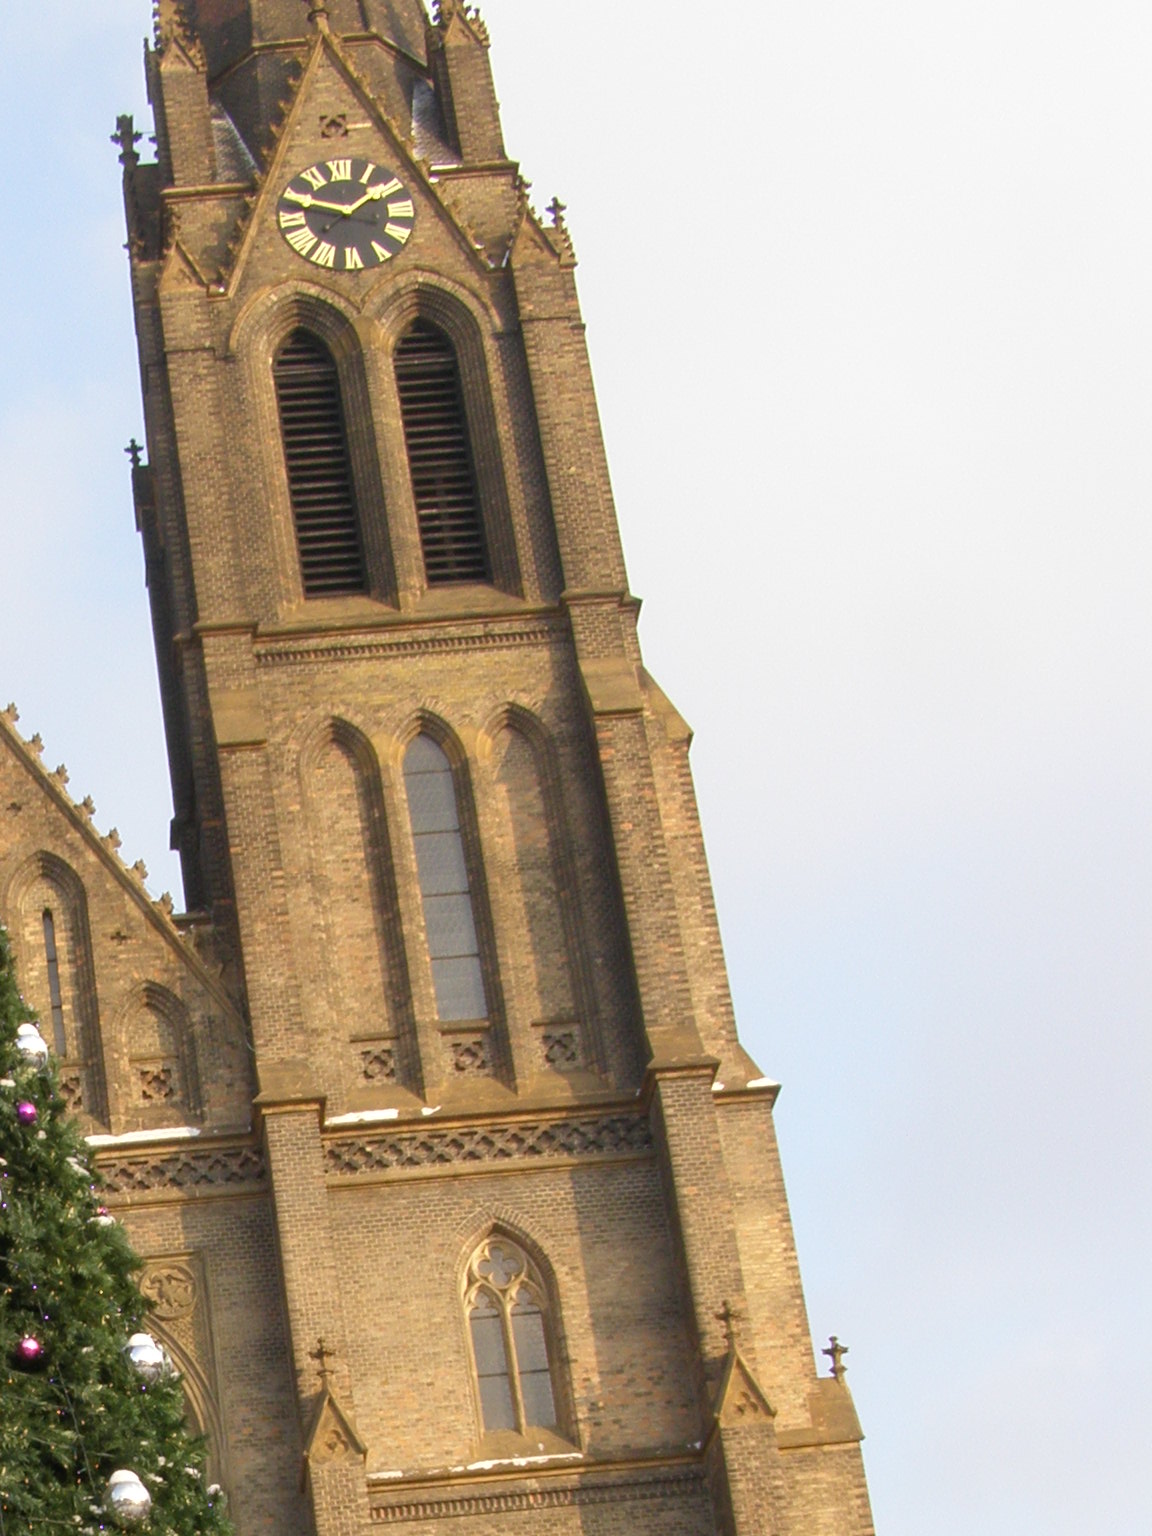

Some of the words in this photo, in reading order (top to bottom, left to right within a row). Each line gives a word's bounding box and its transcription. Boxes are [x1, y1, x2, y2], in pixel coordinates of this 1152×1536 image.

[300, 166, 327, 190] XI
[326, 159, 352, 182] XII
[381, 177, 404, 198] II
[387, 199, 414, 218] III
[286, 227, 318, 256] VIII
[371, 241, 392, 262] V
[310, 241, 335, 267] VII
